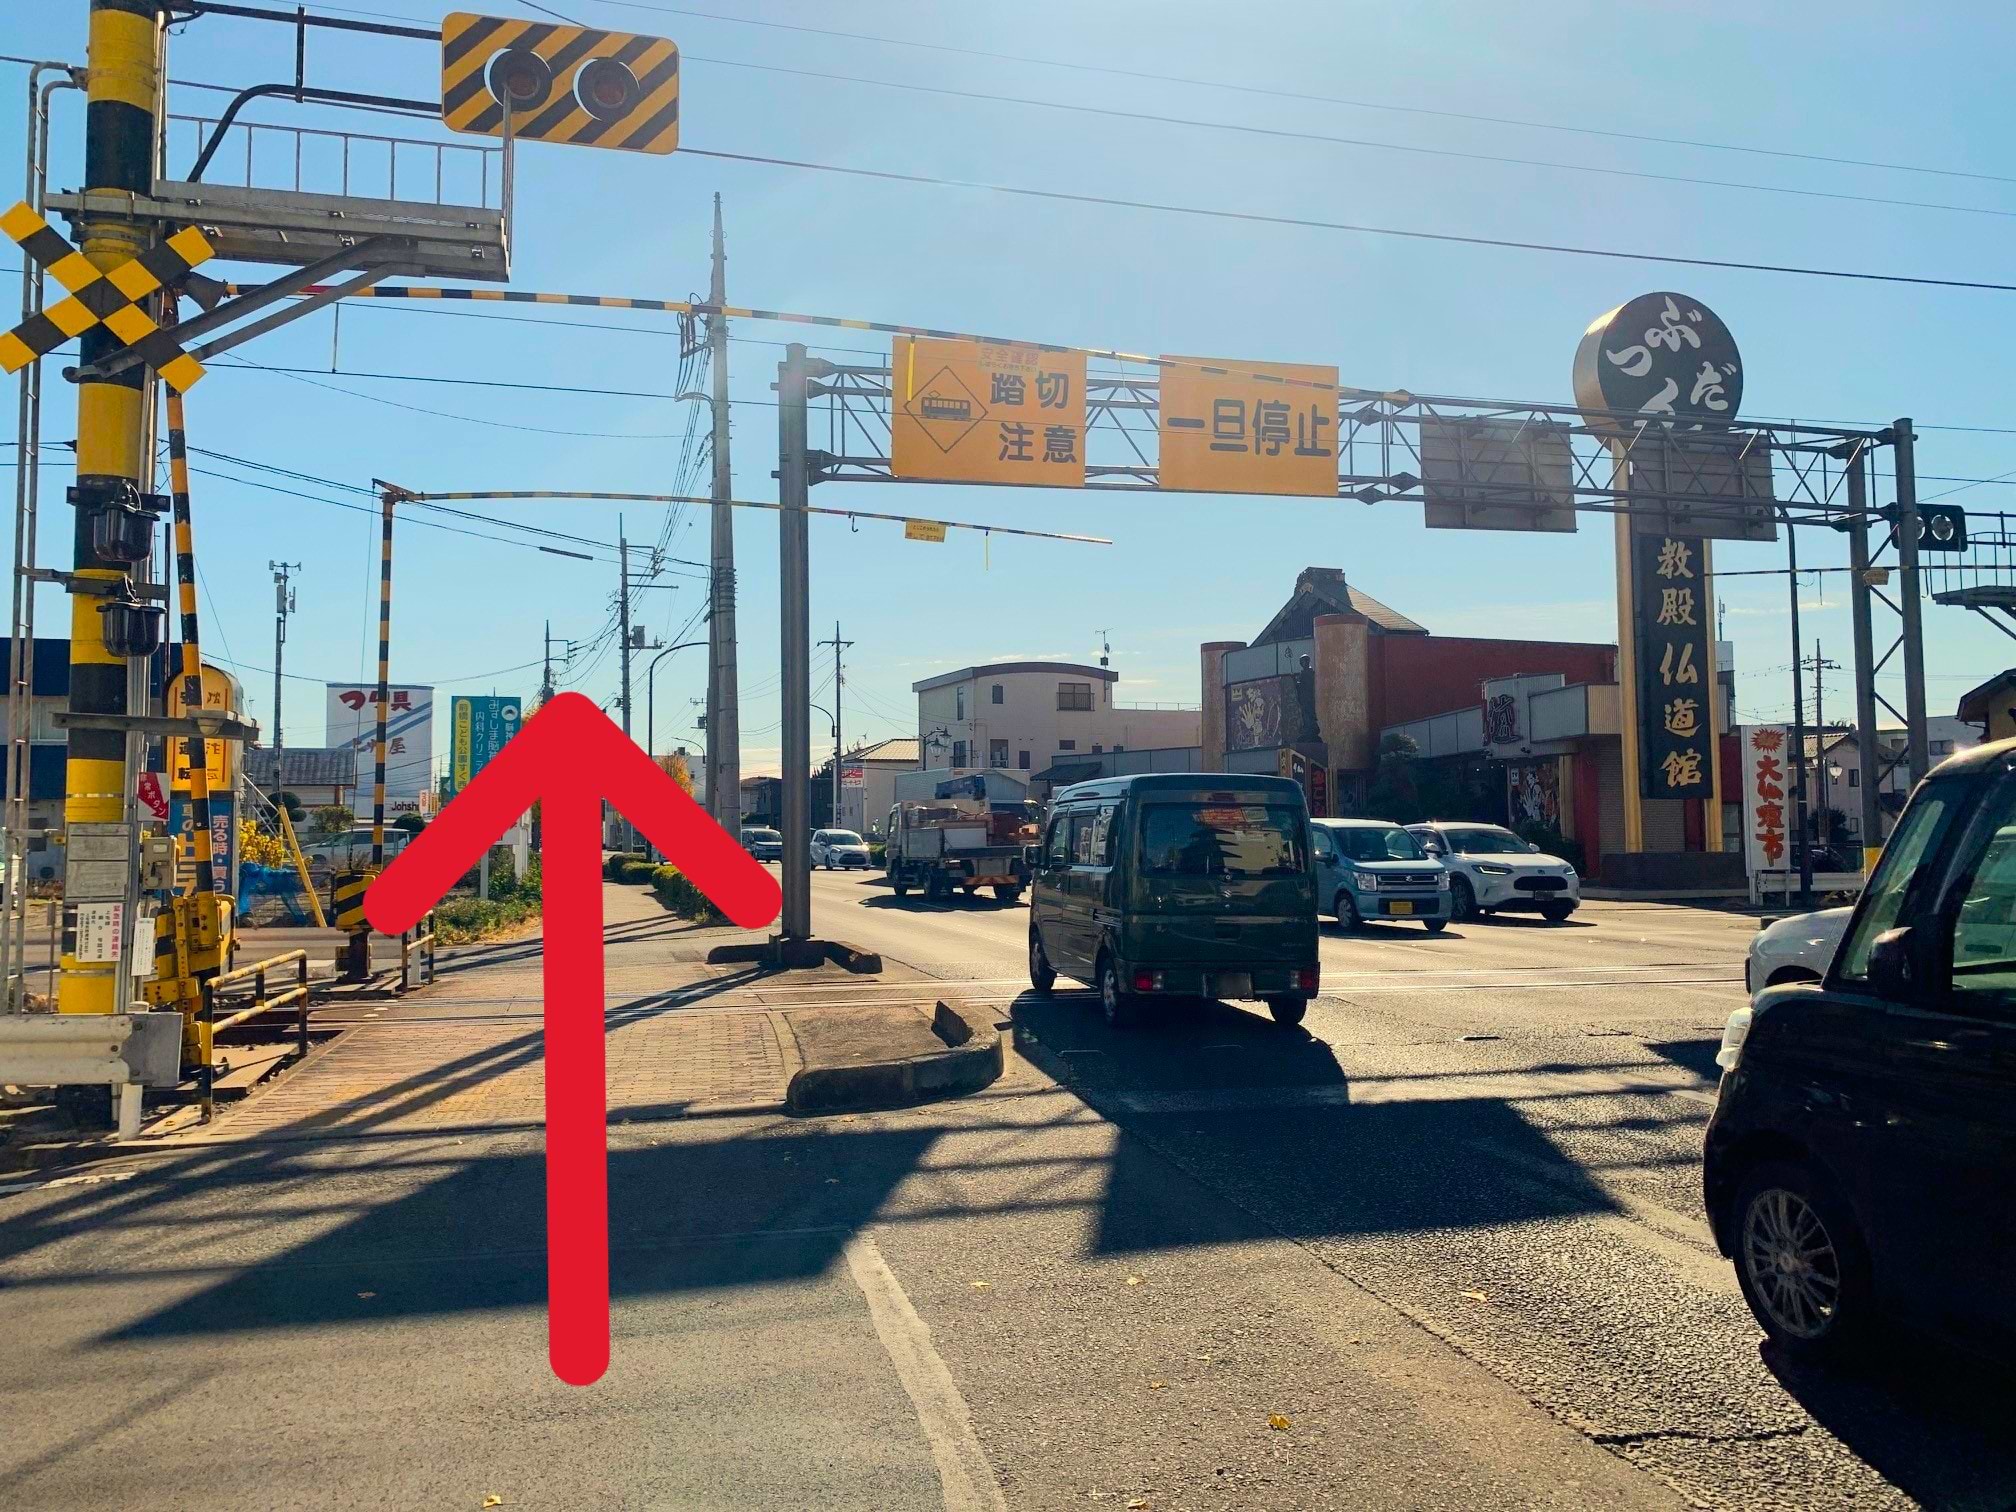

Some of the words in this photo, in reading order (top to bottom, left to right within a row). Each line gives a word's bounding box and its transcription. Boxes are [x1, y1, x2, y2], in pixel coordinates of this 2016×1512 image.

[990, 371, 1069, 409] 踏切
[999, 421, 1077, 463] 注意
[1166, 398, 1332, 457] 一旦停止
